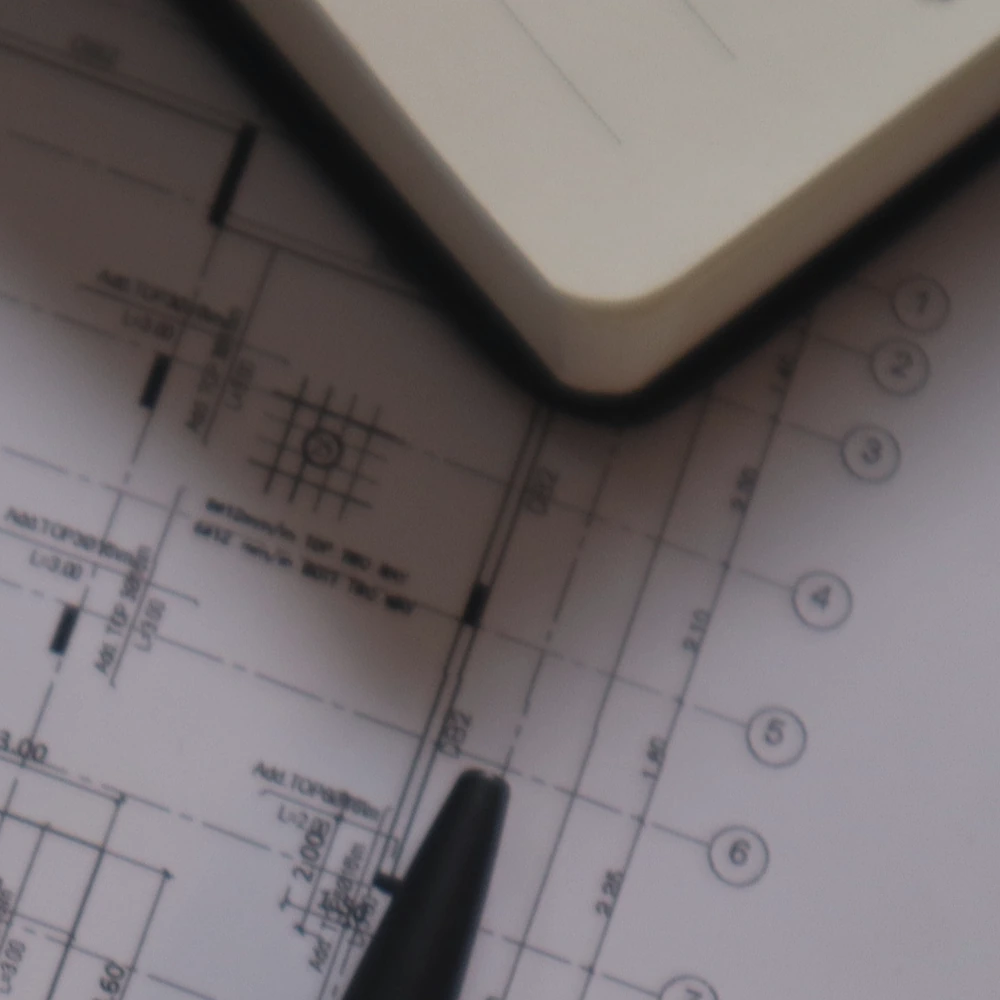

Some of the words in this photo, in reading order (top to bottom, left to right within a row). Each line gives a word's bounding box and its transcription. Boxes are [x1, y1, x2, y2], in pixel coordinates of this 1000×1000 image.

[809, 583, 832, 612] 4
[763, 716, 786, 747] 5
[729, 838, 751, 868] 6
